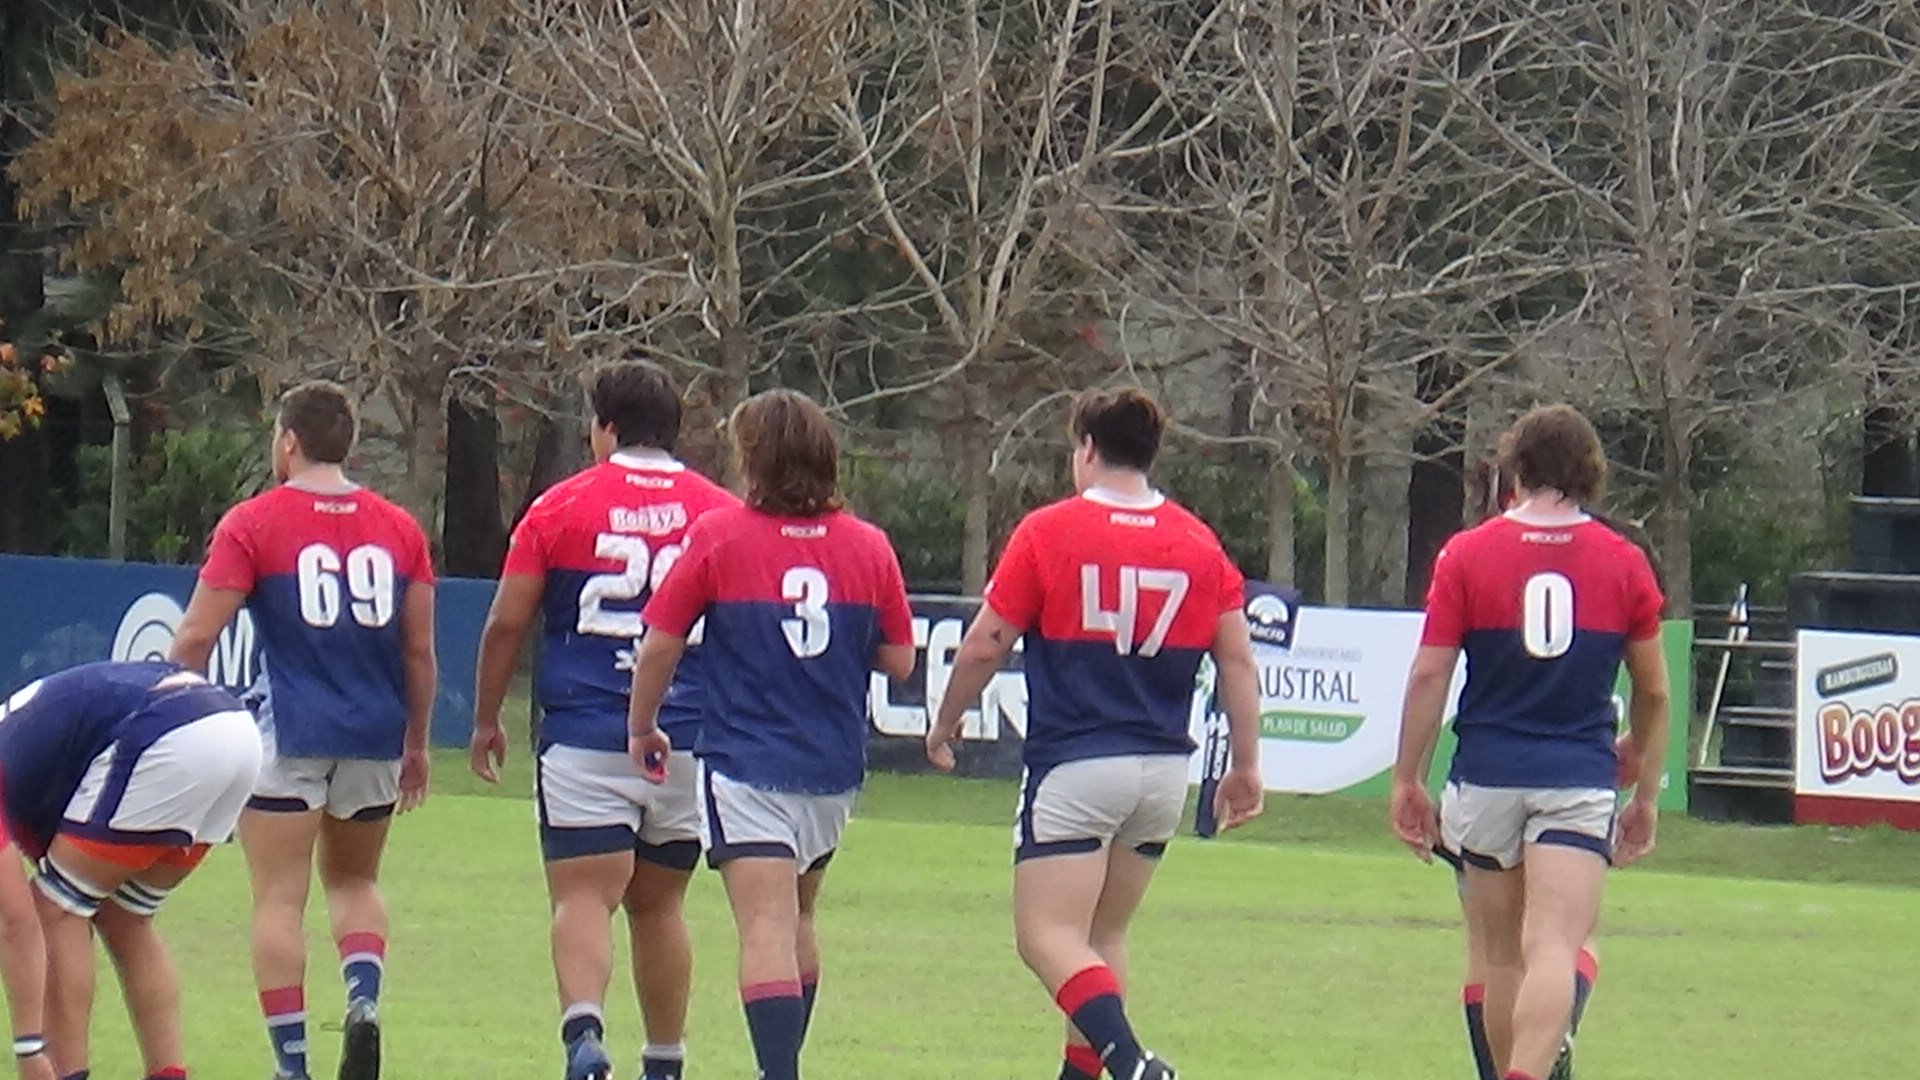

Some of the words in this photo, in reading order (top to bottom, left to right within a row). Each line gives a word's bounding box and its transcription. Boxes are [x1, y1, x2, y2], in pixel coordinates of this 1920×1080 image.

[298, 542, 395, 628] 69
[780, 566, 832, 659] 3
[1080, 563, 1189, 658] 47
[1523, 571, 1575, 660] 0
